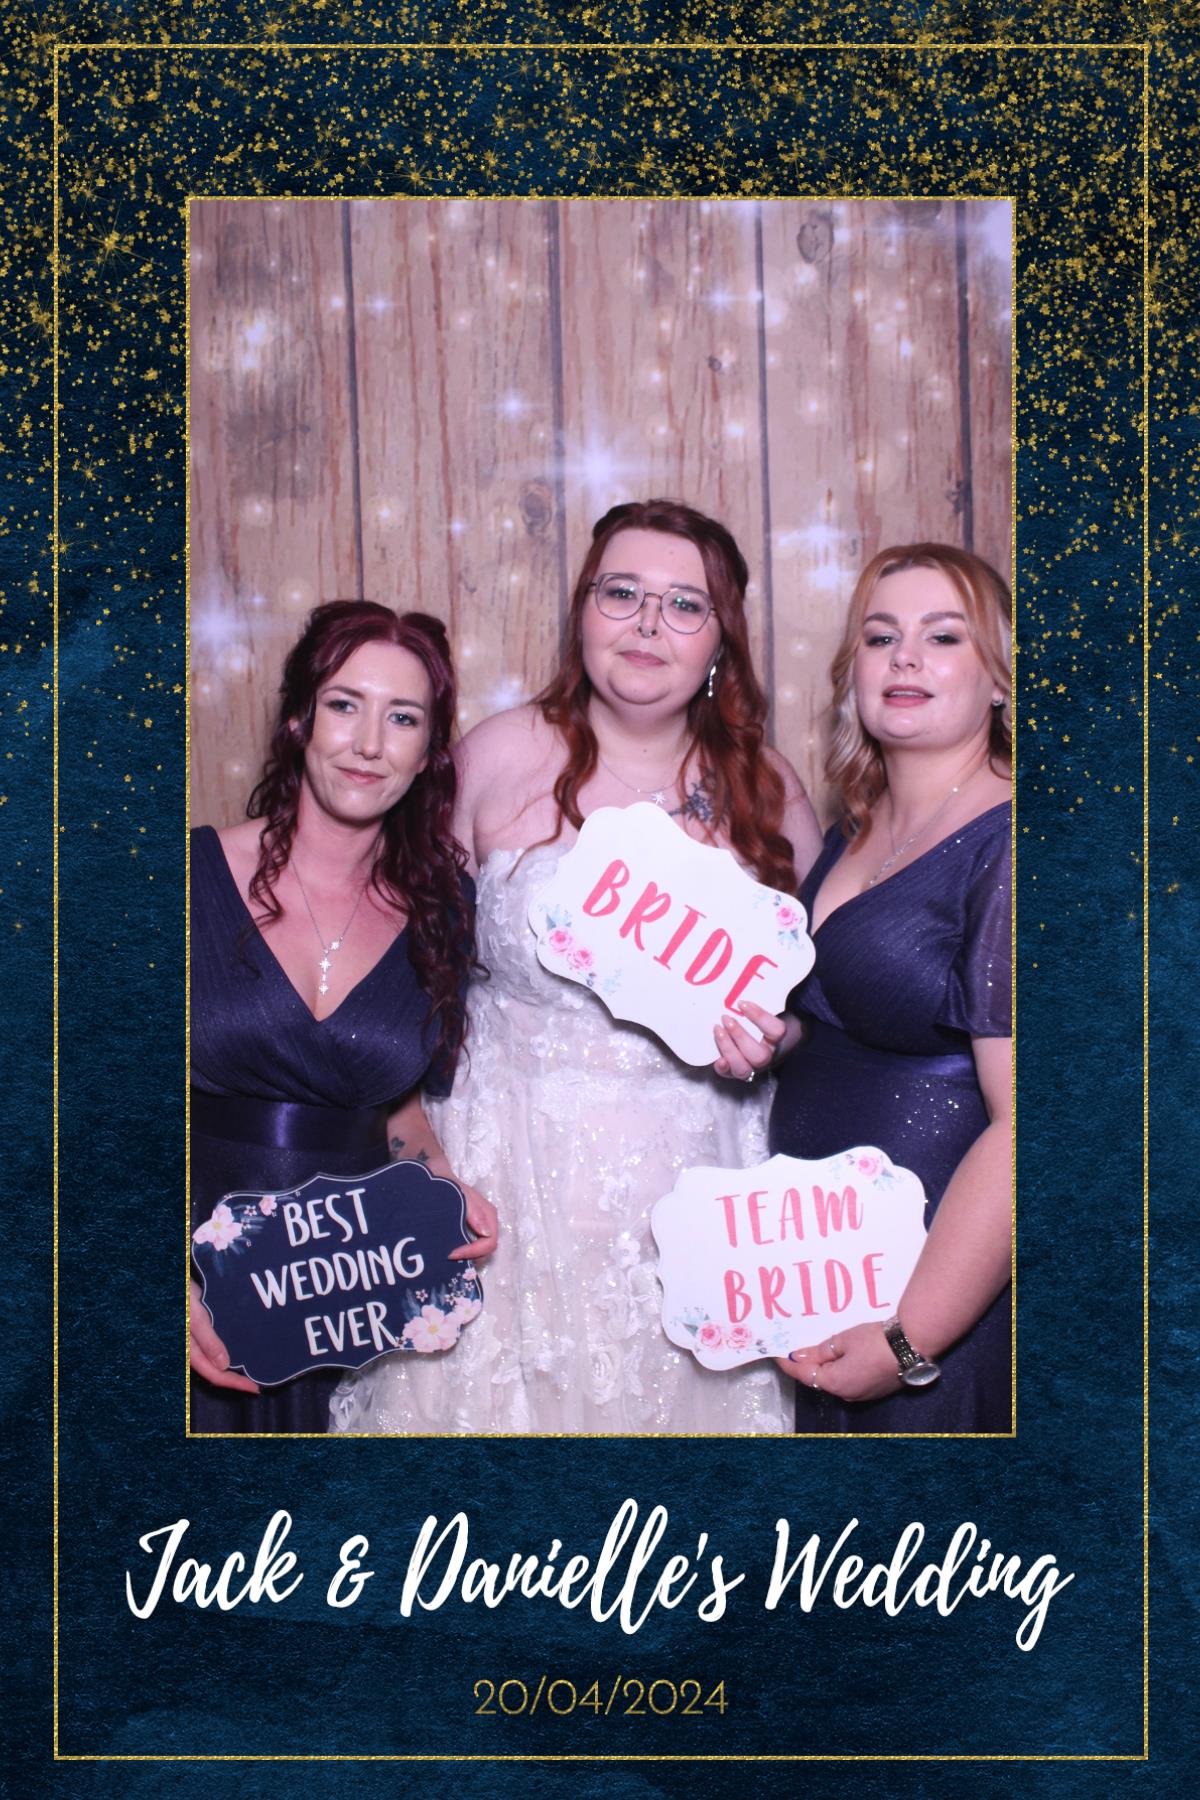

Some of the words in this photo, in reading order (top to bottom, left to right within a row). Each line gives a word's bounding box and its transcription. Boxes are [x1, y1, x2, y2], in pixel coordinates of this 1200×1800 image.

[582, 859, 778, 1016] BRIDE
[283, 1188, 369, 1247] BEST
[715, 1185, 864, 1248] TEAM
[250, 1237, 424, 1309] WEDDING
[724, 1253, 890, 1323] BRIDE
[304, 1301, 398, 1355] EVER
